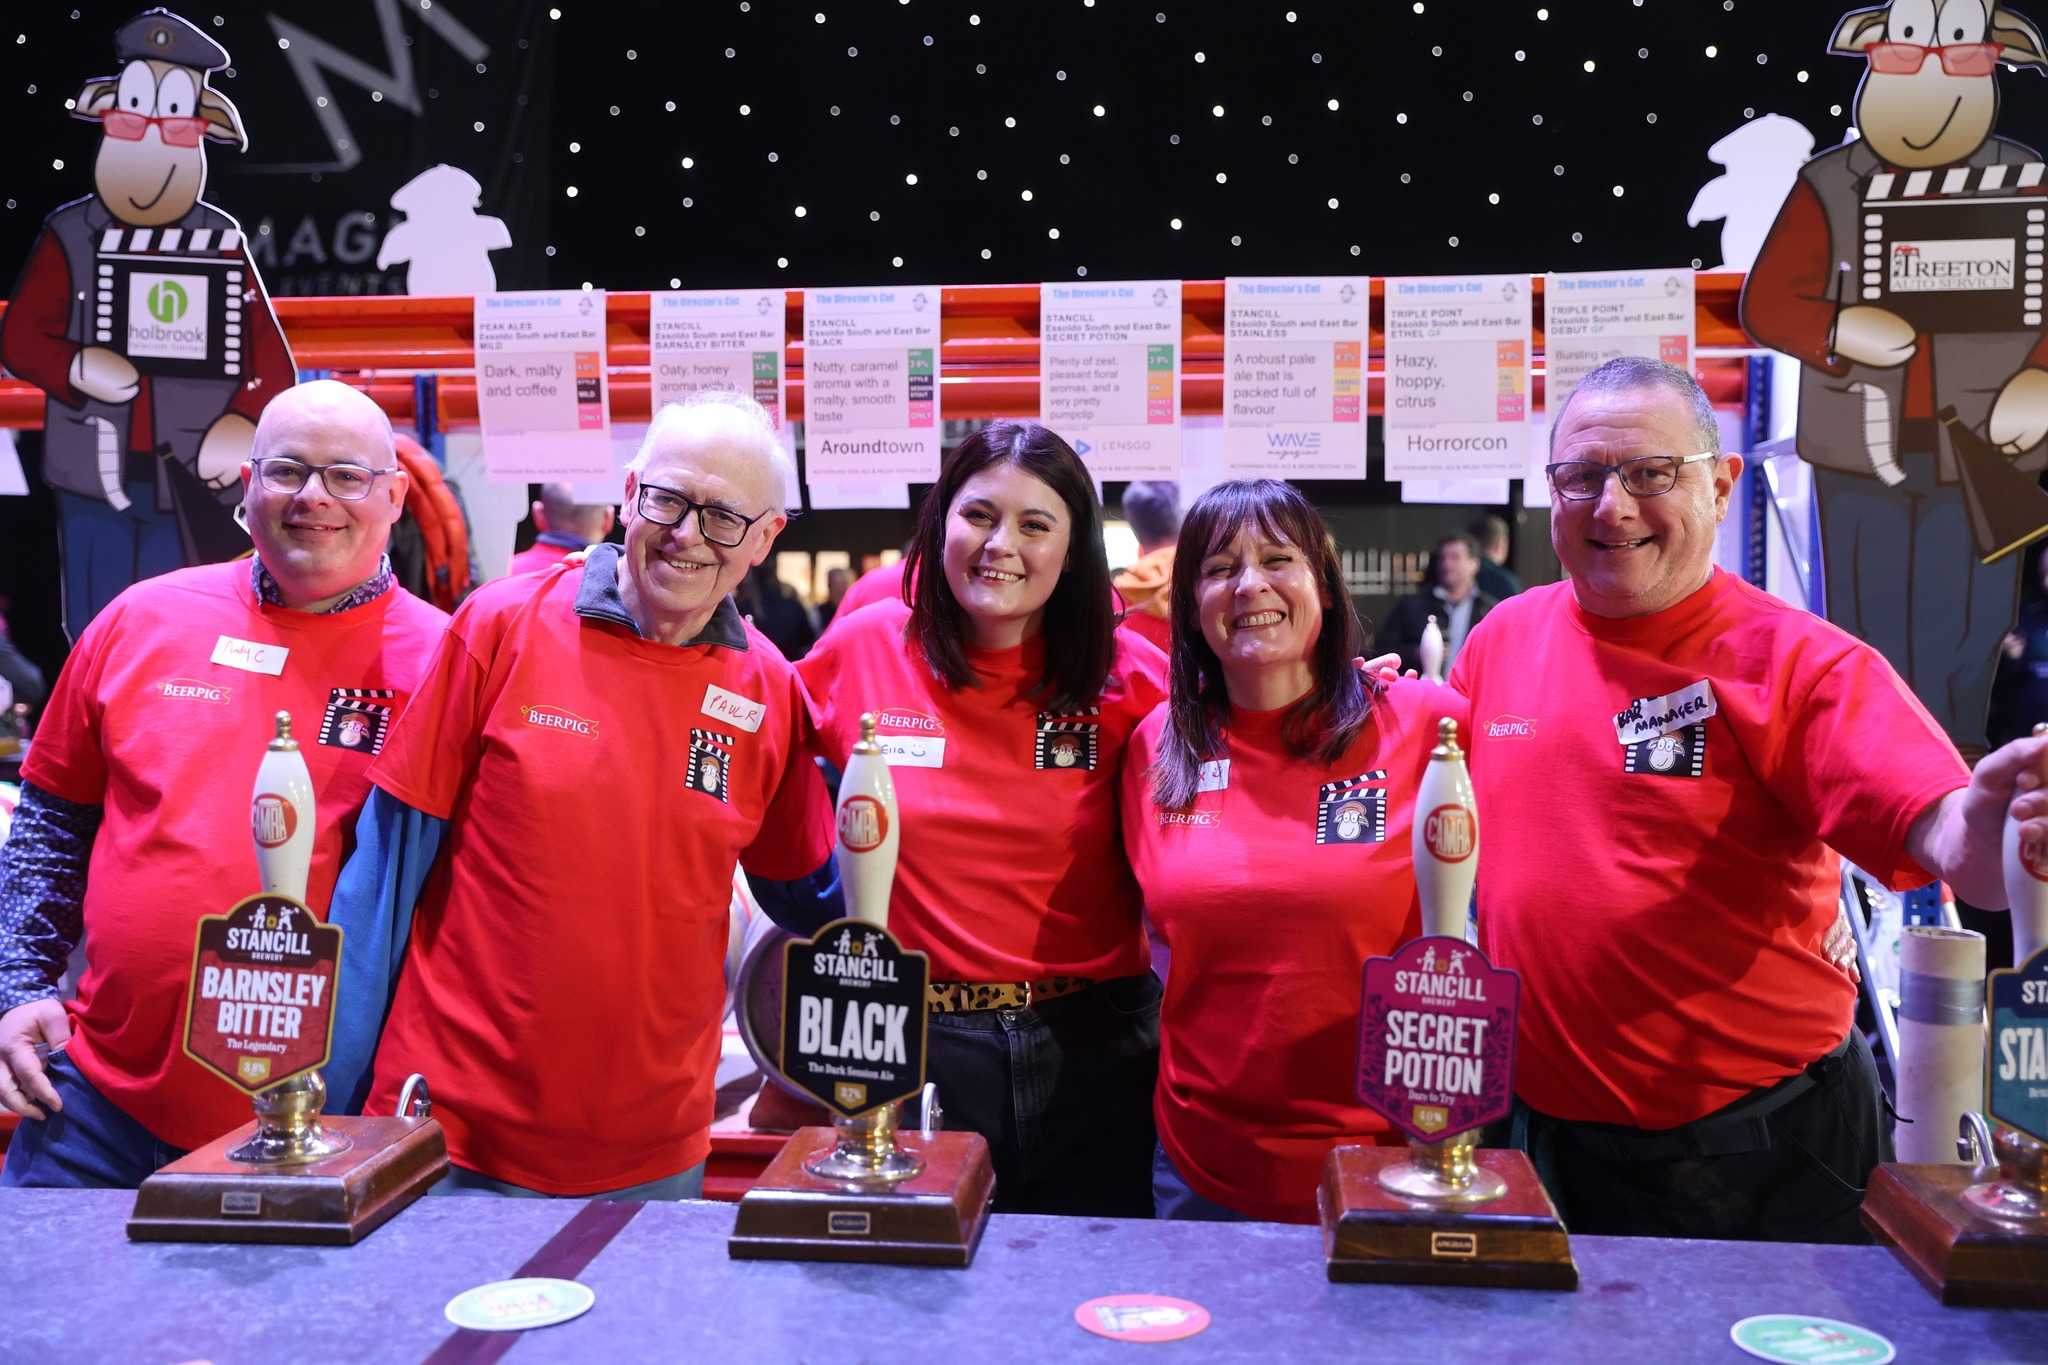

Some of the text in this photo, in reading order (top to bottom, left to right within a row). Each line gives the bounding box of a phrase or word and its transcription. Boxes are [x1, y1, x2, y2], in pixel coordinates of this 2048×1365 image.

[1894, 279, 1935, 290] AUTO
[1230, 310, 1280, 318] STANCILL
[1391, 308, 1463, 319] TRIPLE POINT
[1551, 304, 1624, 315] TRIPLE POINT
[1046, 314, 1095, 322] STANCILL
[129, 324, 205, 343] holbrook
[1046, 332, 1128, 342] SECRET POTION
[1230, 329, 1287, 338] STAINLESS
[655, 340, 746, 349] BARNSLEY BITTER
[809, 338, 843, 347] BLACK
[1233, 353, 1316, 366] A robust pale
[1556, 348, 1623, 361] Bursting with
[813, 360, 898, 375] Nutty, caramel
[1050, 356, 1080, 368] Plenty
[1083, 356, 1093, 366] of
[1395, 353, 1438, 370] Hazy,
[485, 364, 562, 379] Dark, malty
[693, 364, 730, 377] honey
[1050, 370, 1118, 381] pleasant floral
[1233, 370, 1294, 381] ale that is
[660, 382, 697, 391] aroma
[813, 377, 890, 389] aroma with a
[1092, 383, 1110, 392] and
[1395, 375, 1445, 390] hoppy,
[486, 383, 557, 397] and coffee
[1233, 387, 1317, 399] packed full of
[814, 394, 896, 407] malty, smooth
[1050, 397, 1101, 408] very pretty
[1395, 394, 1436, 409] citrus
[1050, 410, 1093, 421] pumpclip
[1233, 404, 1275, 415] flavour
[814, 411, 843, 422] taste
[821, 439, 924, 454] Aroundtown
[1101, 440, 1152, 451] LENSGO
[1408, 435, 1508, 452] Horrorcon
[254, 650, 265, 663] C
[163, 683, 221, 700] BEERPIG
[709, 695, 757, 723] PAUL R
[1635, 696, 1707, 735] MANAGER
[528, 709, 590, 734] BEERPIG
[881, 713, 935, 730] BEERPIG
[1617, 704, 1642, 728] BAR
[1488, 723, 1529, 736] BEERPIG
[226, 927, 311, 956] STANCILL
[251, 952, 283, 962] BREWERY
[813, 953, 898, 982] STANCILL
[201, 966, 326, 1007] BARNSLEY
[839, 978, 871, 988] BREWERY
[1395, 971, 1486, 1001] STANCILL
[1422, 996, 1455, 1007] BREWERY
[217, 1001, 302, 1038] BITTER
[799, 995, 909, 1064] BLACK
[1385, 1009, 1488, 1056] SECRET
[227, 1038, 287, 1054] The Legendary
[808, 1061, 894, 1081] The Dark Session Ale
[1385, 1049, 1483, 1095] POTION
[1440, 1093, 1455, 1106] Try
